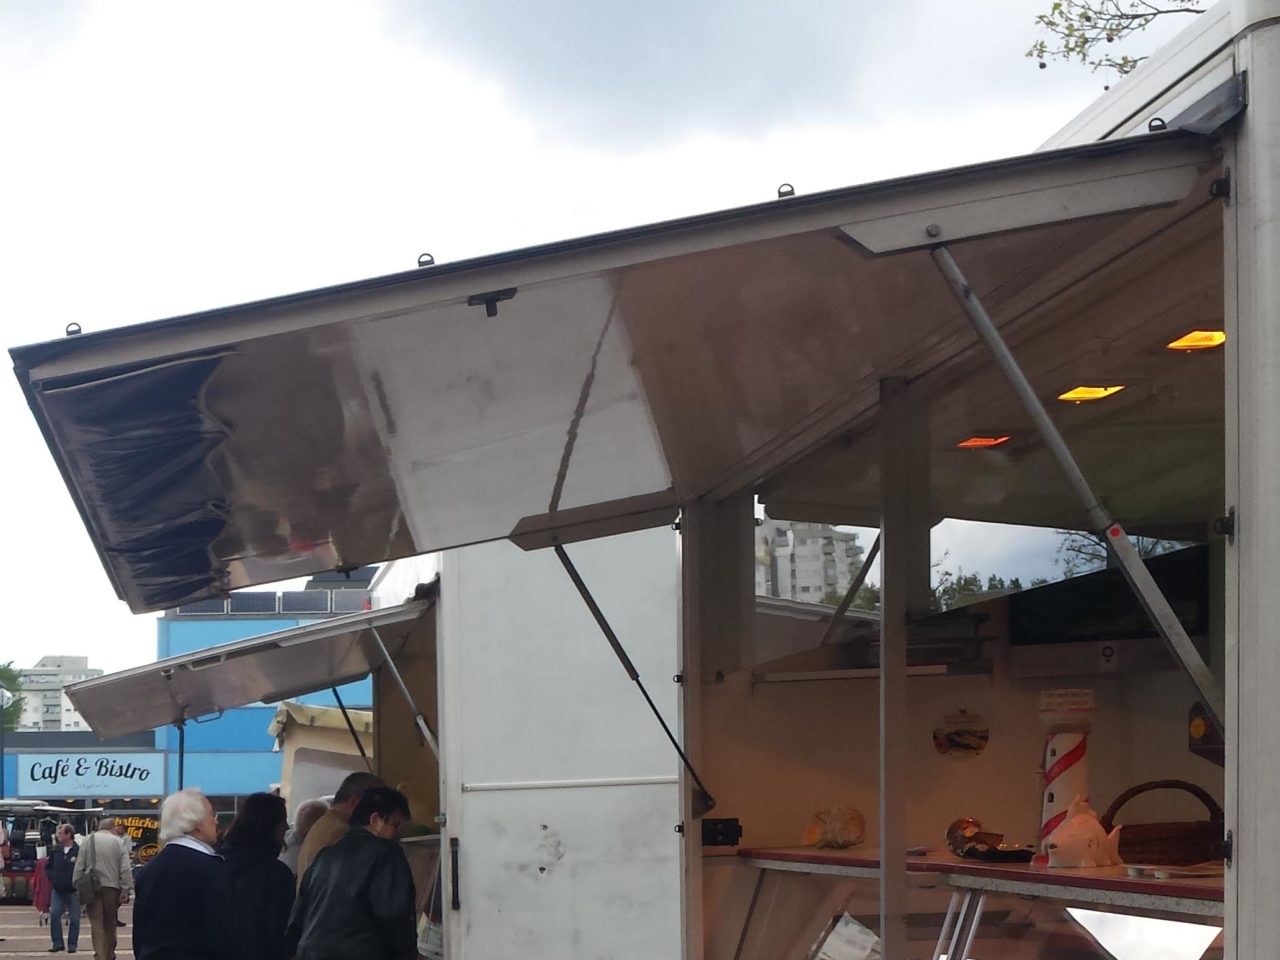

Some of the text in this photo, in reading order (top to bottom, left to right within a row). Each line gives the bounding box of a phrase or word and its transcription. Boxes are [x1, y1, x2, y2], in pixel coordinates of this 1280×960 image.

[30, 757, 152, 784] Café & Bistro
